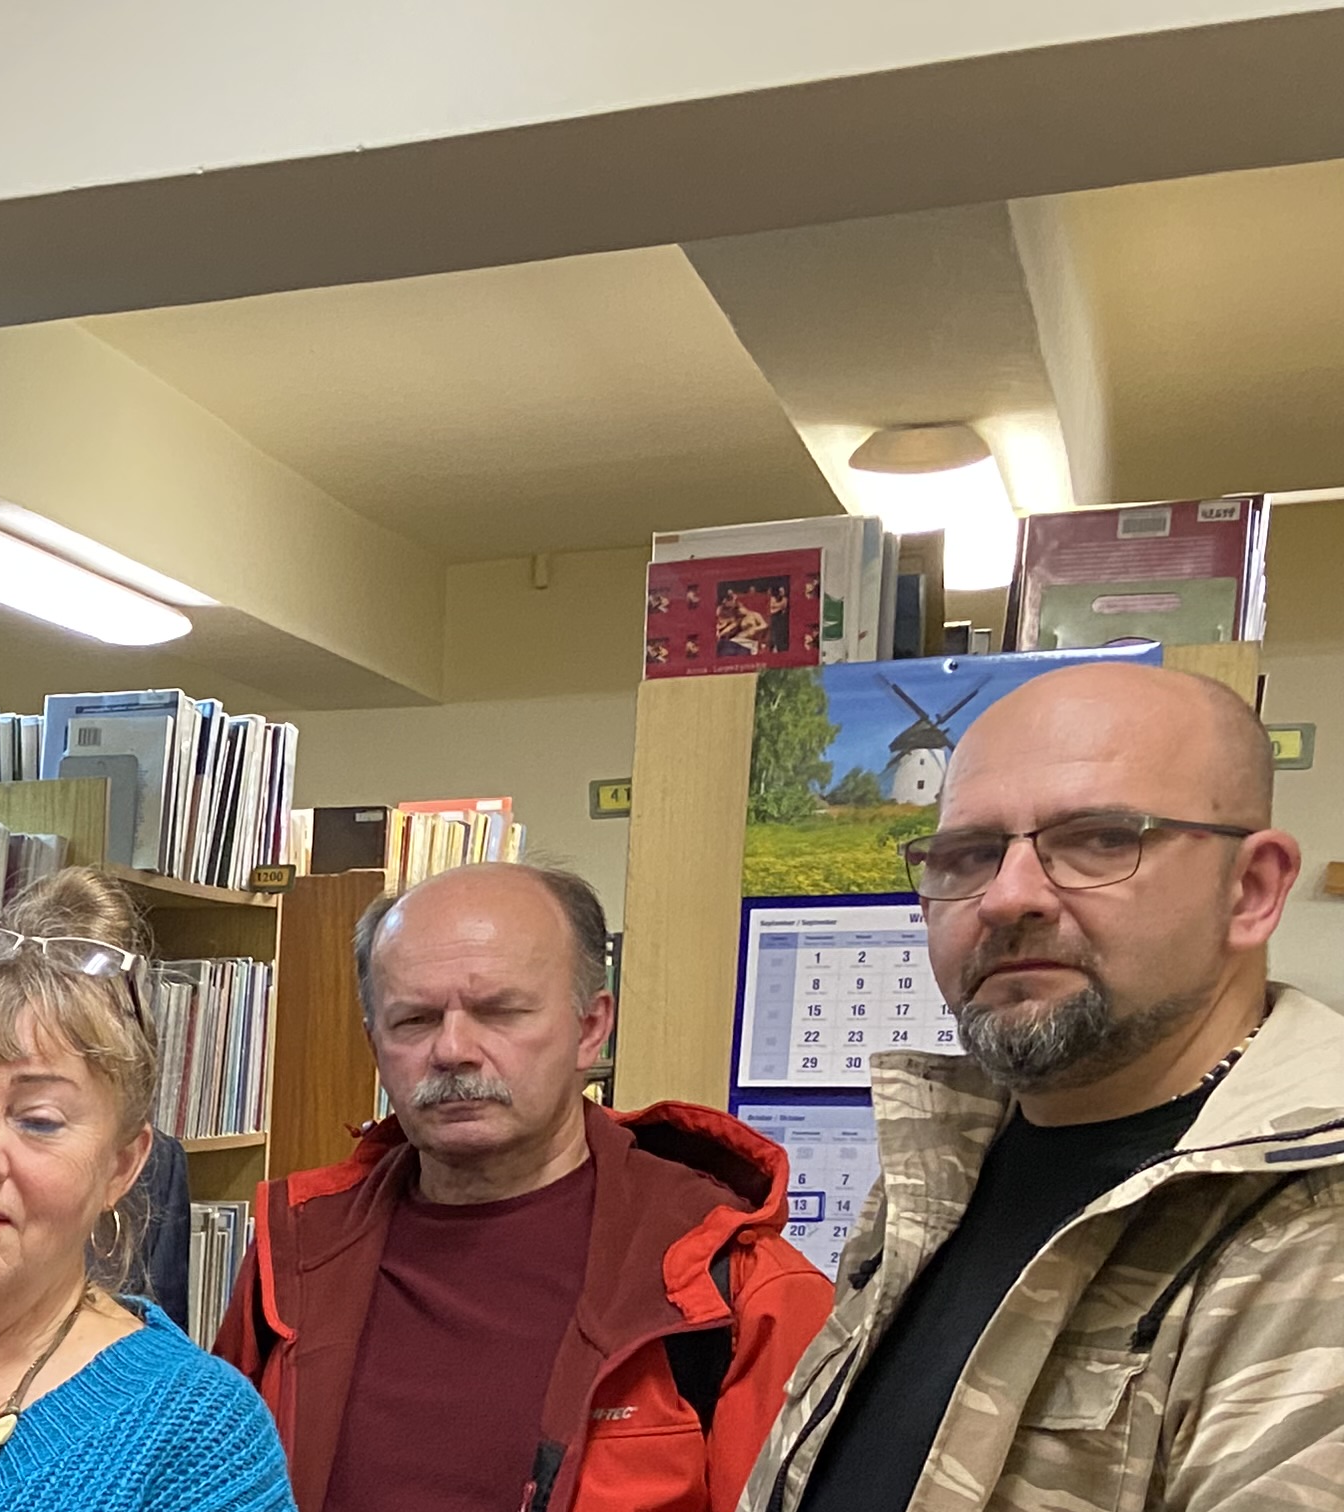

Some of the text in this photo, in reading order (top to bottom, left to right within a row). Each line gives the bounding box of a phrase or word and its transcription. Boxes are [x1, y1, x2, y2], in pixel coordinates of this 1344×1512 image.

[256, 871, 283, 882] 1200
[815, 951, 910, 963] 1 2 3
[812, 977, 912, 990] 8 9 10
[807, 1005, 821, 1016] 15
[851, 1004, 865, 1016] 16
[896, 1004, 909, 1015] 17
[804, 1030, 953, 1043] 22 23 24 25
[802, 1057, 861, 1068] 29 30
[798, 1173, 849, 1185] 6 7
[794, 1199, 850, 1211] 13 14
[790, 1225, 847, 1237] 20 21
